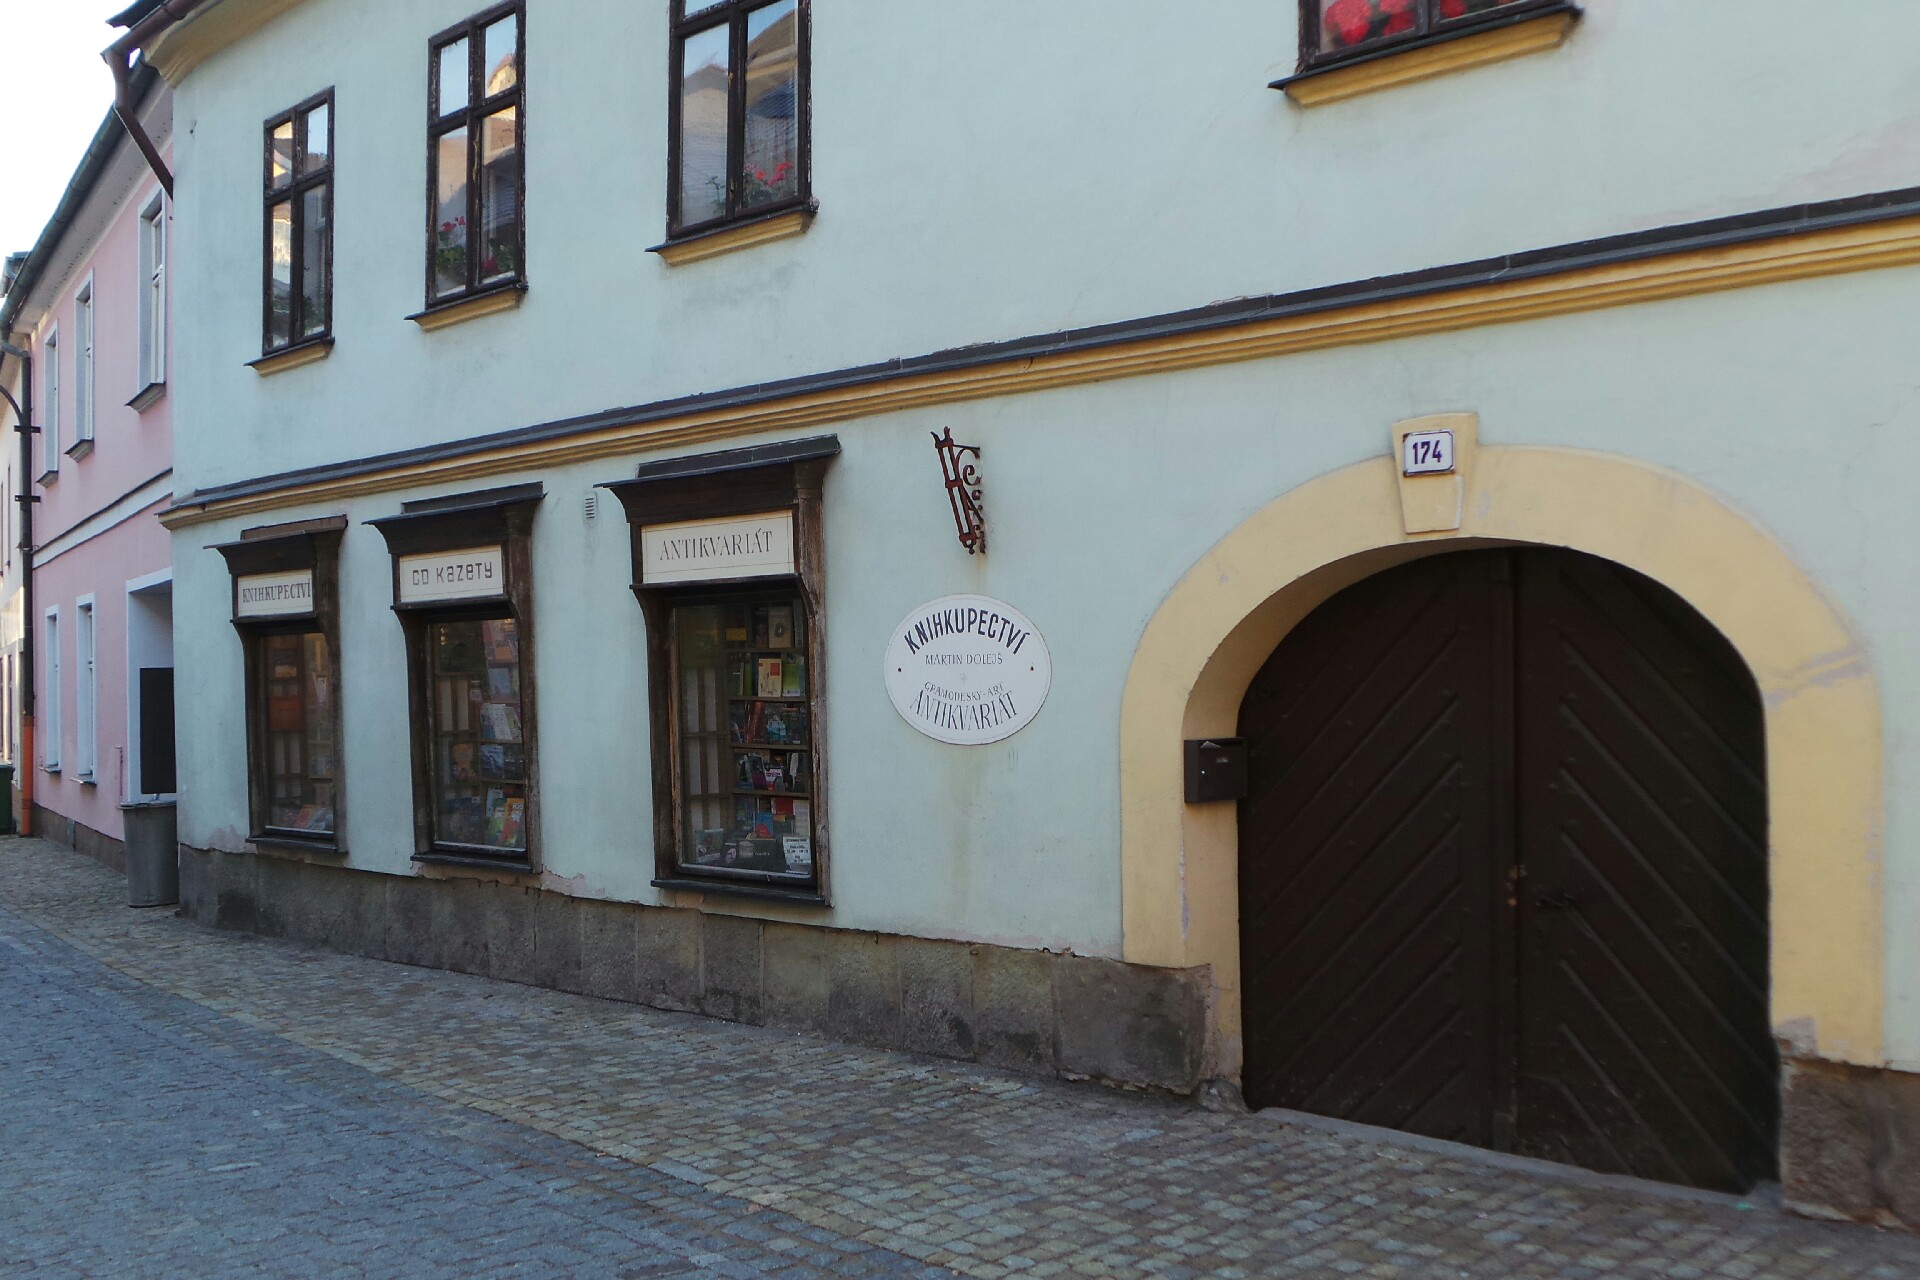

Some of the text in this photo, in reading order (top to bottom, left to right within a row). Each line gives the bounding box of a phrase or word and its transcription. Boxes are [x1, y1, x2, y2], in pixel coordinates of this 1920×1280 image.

[1412, 439, 1442, 465] 174
[659, 528, 773, 561] ANTIKVARIÁT
[412, 569, 429, 586] CD
[242, 578, 311, 603] KNIHKUPECTVÍ
[904, 608, 1030, 654] KNIHKUPECTVÍ
[925, 652, 1003, 666] MARTIN DOLEJŠ
